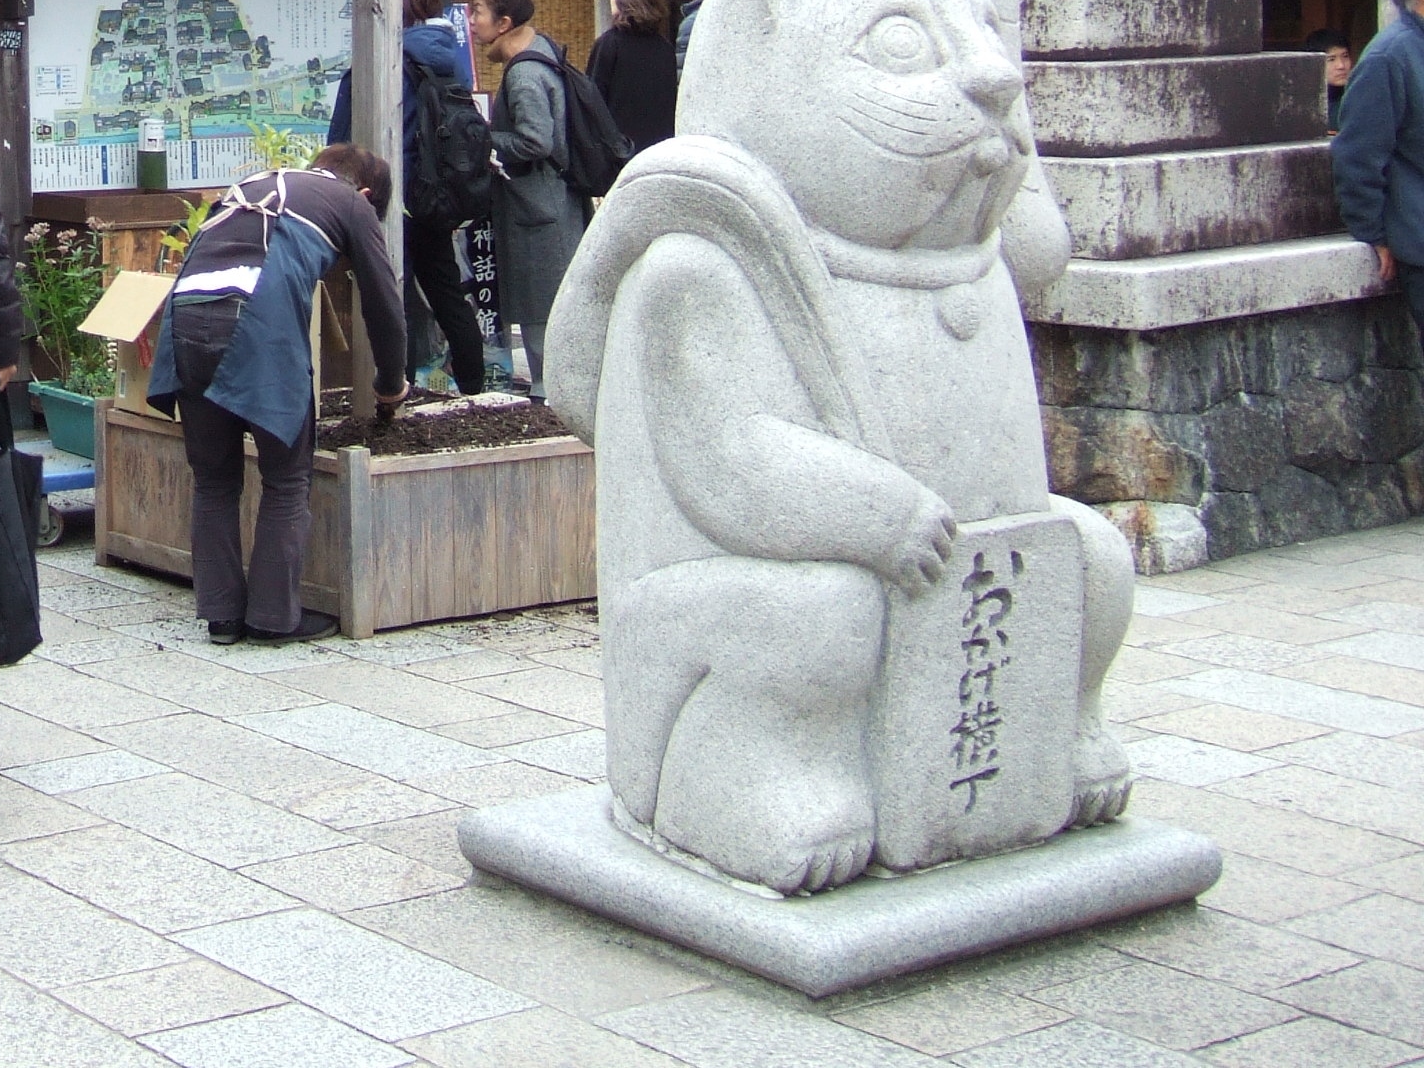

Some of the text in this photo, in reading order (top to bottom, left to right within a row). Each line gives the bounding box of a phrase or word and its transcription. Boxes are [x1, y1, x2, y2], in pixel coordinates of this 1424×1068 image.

[473, 221, 497, 338] 神話の館
[949, 550, 1024, 814] おかげ横丁
